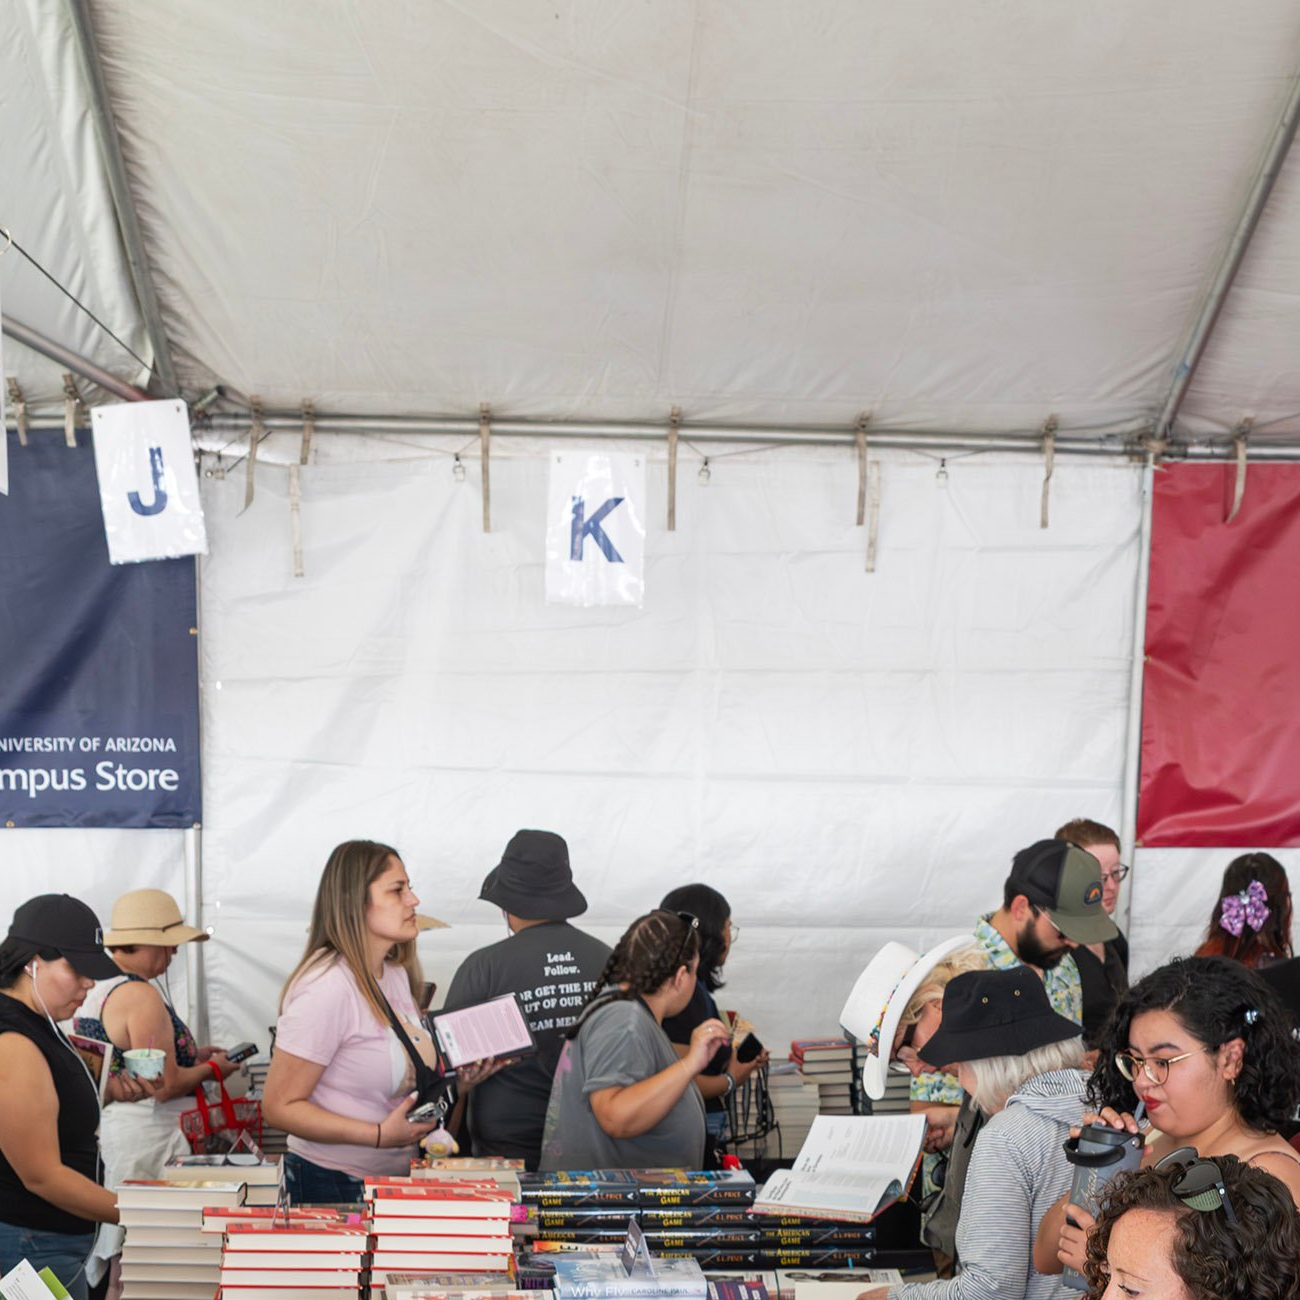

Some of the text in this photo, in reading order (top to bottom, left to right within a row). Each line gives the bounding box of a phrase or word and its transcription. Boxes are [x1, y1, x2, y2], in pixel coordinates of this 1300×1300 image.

[127, 446, 168, 517] J
[570, 496, 625, 563] K
[79, 737, 100, 752] OF
[105, 737, 177, 752] ARIZONA
[95, 761, 179, 792] Store
[547, 952, 574, 963] Lead.
[544, 964, 580, 977] Follow.
[535, 982, 582, 999] GET THE
[543, 996, 583, 1010] OF OUR
[661, 1196, 681, 1206] GAME
[571, 1285, 688, 1299] Why Fly CAROLINE PAUL
